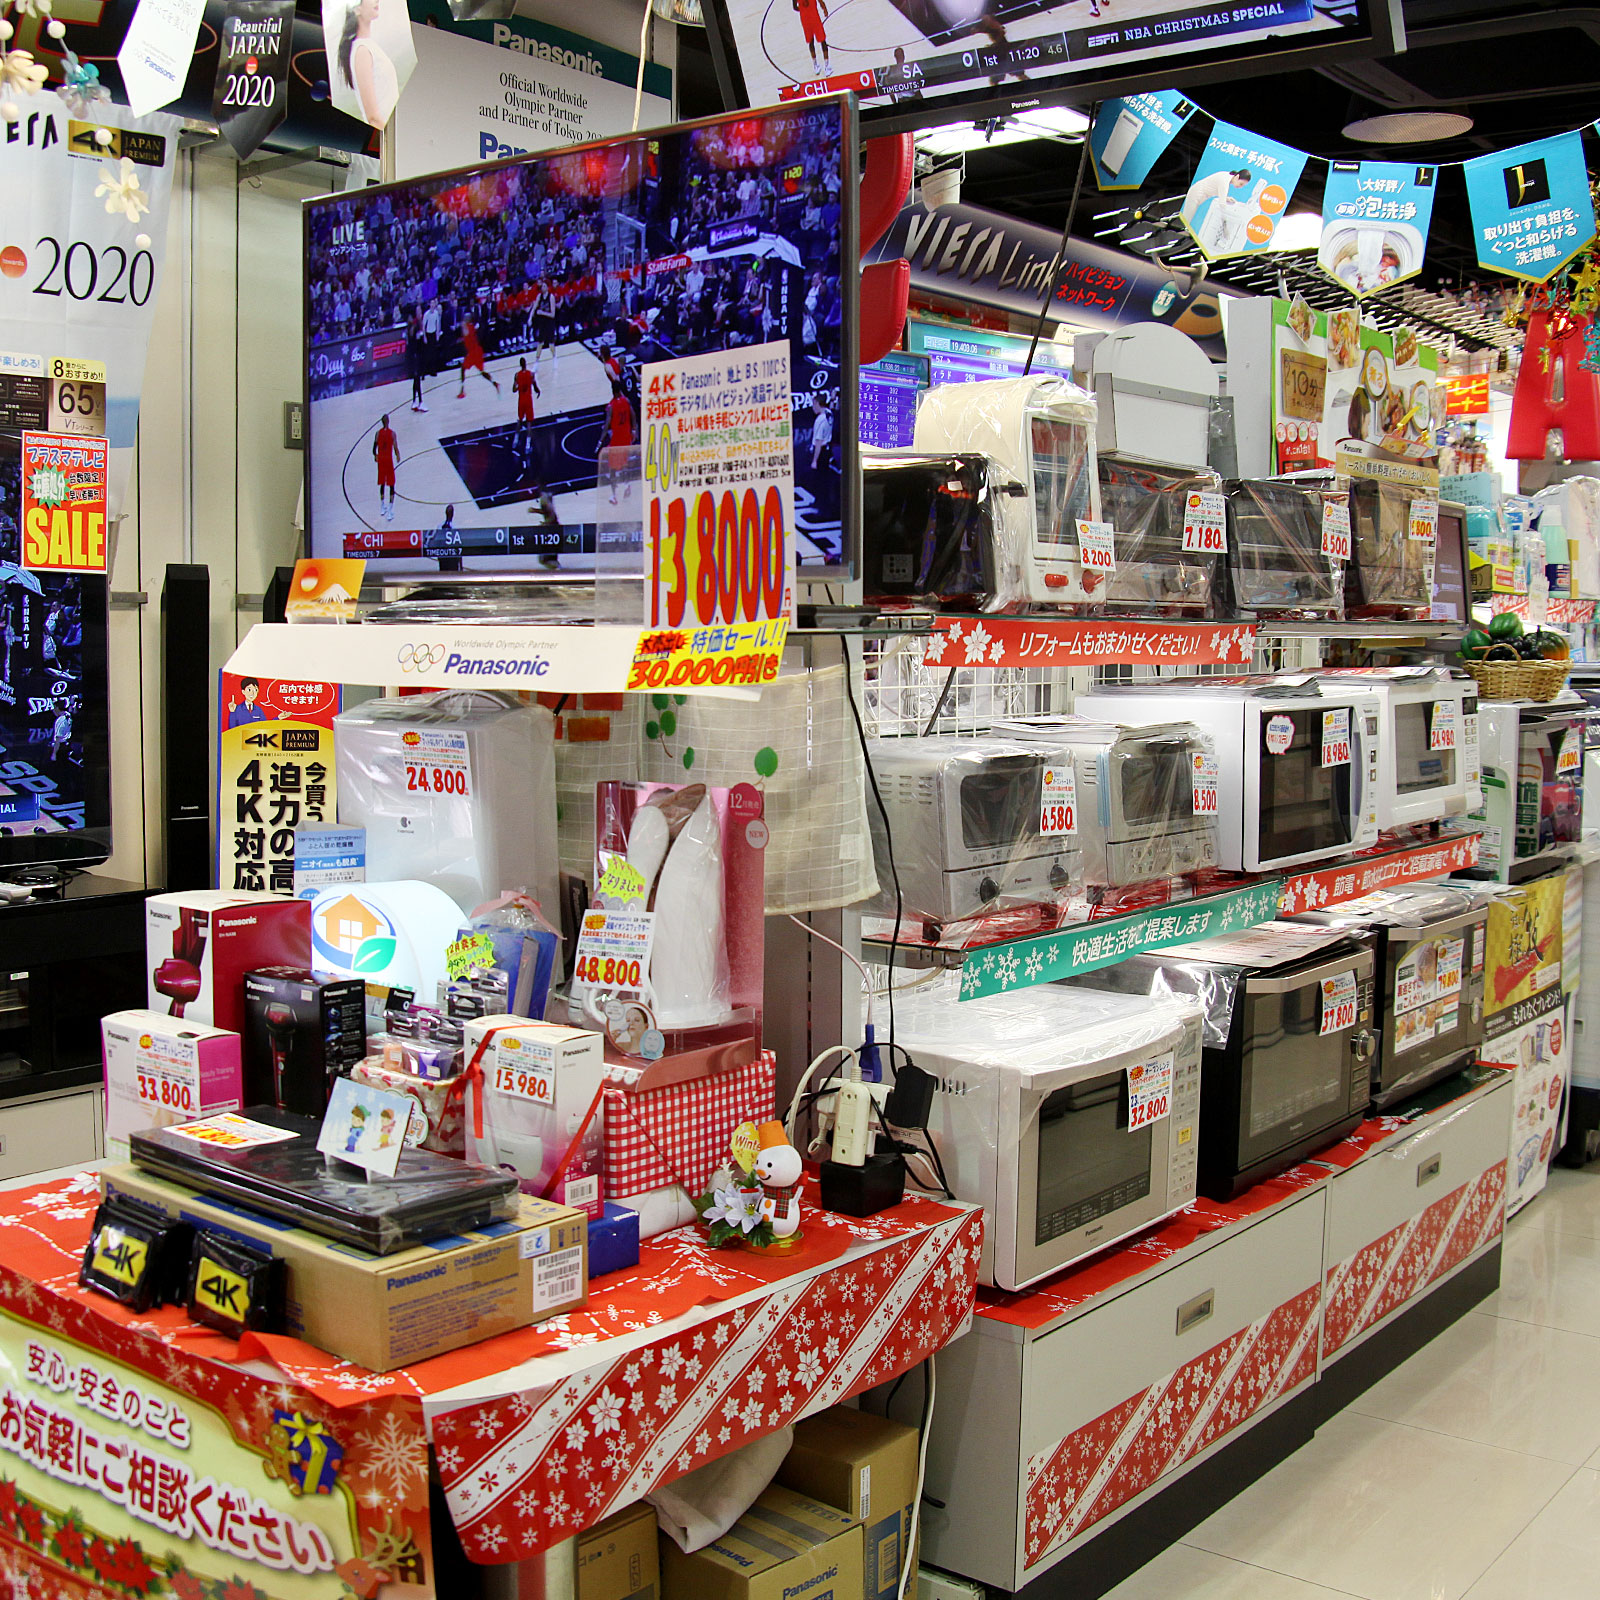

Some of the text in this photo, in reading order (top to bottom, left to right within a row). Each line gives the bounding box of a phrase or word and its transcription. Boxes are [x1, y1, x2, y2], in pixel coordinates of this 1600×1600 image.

[233, 17, 282, 34] Beautiful
[1088, 32, 1118, 47] ESPN
[1125, 27, 1152, 40] NBA
[1154, 13, 1230, 35] CHRISTMAS
[1232, 3, 1284, 22] SPECIAL
[228, 36, 280, 59] JAPAN
[493, 22, 603, 78] Panasonic
[982, 47, 1041, 67] 1st 11:20
[144, 56, 176, 82] Panasonic
[902, 52, 973, 79] SA 0
[222, 74, 276, 107] 2020
[499, 71, 588, 110] Official Worldwide
[804, 73, 870, 97] CHI 0
[881, 80, 926, 95] TIMEOUTS: 7
[504, 91, 583, 125] Olympic Partner
[1010, 98, 1041, 110] Panasonic
[478, 103, 584, 144] and Partner of Tokyo
[124, 135, 161, 151] JAPAN
[124, 149, 160, 162] PREMIUM
[1209, 132, 1285, 175] スッと奥まで 手が届く
[1362, 184, 1400, 201] 大好評
[1363, 194, 1417, 221] 泡洗浄
[332, 220, 365, 247] LIVE
[1483, 207, 1581, 241] 取り出す負担を、
[330, 243, 367, 258] サンアントニオ
[904, 211, 1005, 285] VIERA
[1491, 223, 1577, 255] ぐっと和らげる
[1514, 243, 1562, 267] 洗濯機。
[33, 236, 155, 307] 2020
[1066, 262, 1126, 294] ハイビジョン
[1056, 283, 1116, 313] ネットワーク
[350, 340, 406, 362] abc ESPN
[54, 359, 64, 378] 8
[65, 369, 104, 381] おすすめ!!
[316, 354, 345, 379] Day
[681, 367, 722, 391] Panasonic
[648, 374, 676, 397] 4K
[680, 381, 788, 413] デジタルハイビジョン液晶テレビ
[58, 382, 95, 416] 65
[647, 397, 678, 420] 対応
[27, 508, 105, 567] SALE
[364, 529, 627, 548] CHI 0 SA 0 1st 11:20 4.7 ESPN
[1186, 525, 1221, 549] 7,180
[1322, 533, 1347, 555] 8,500
[347, 549, 375, 558] TIMEOUTS:
[426, 546, 456, 556] TIMEOUTS:
[1082, 547, 1112, 567] 8,200
[453, 639, 559, 652] Worldwide Olympic Partner
[691, 621, 787, 655] 特価セール!!
[1019, 632, 1202, 657] リフォームもおまかせください!
[444, 653, 549, 688] Panasonic
[628, 653, 779, 689] 30,000円引き
[278, 684, 323, 694] 店内で体感
[282, 695, 319, 705] できます!
[244, 733, 279, 749] 4K
[285, 731, 316, 742] JAPAN
[285, 741, 316, 750] PREMIUM
[406, 766, 466, 796] 24,800
[1193, 788, 1217, 812] 8,500
[234, 759, 265, 892] 4K対応
[1041, 806, 1073, 832] 6,580
[301, 860, 322, 869] ニオイ
[150, 909, 173, 921] Panasonic
[218, 916, 257, 928] Panasonic
[1072, 912, 1212, 979] 快適生活をご提案します
[576, 956, 640, 987] 48,800
[246, 980, 275, 993] Panasonic
[323, 989, 348, 997] Panasonic
[1320, 1002, 1354, 1033] 37,800
[108, 1030, 130, 1043] Panasonic
[562, 1046, 592, 1057] Panasonic
[137, 1075, 191, 1110] 33,800
[495, 1069, 547, 1099] 15,980
[1131, 1096, 1167, 1127] 32,800
[102, 1243, 141, 1279] 4K
[386, 1263, 448, 1291] Panasonic
[201, 1275, 241, 1316] 4K
[28, 1343, 186, 1442] 安心・安全のこと
[1, 1388, 327, 1567] お気軽にご相談ください
[782, 1564, 838, 1600] Panasonic
